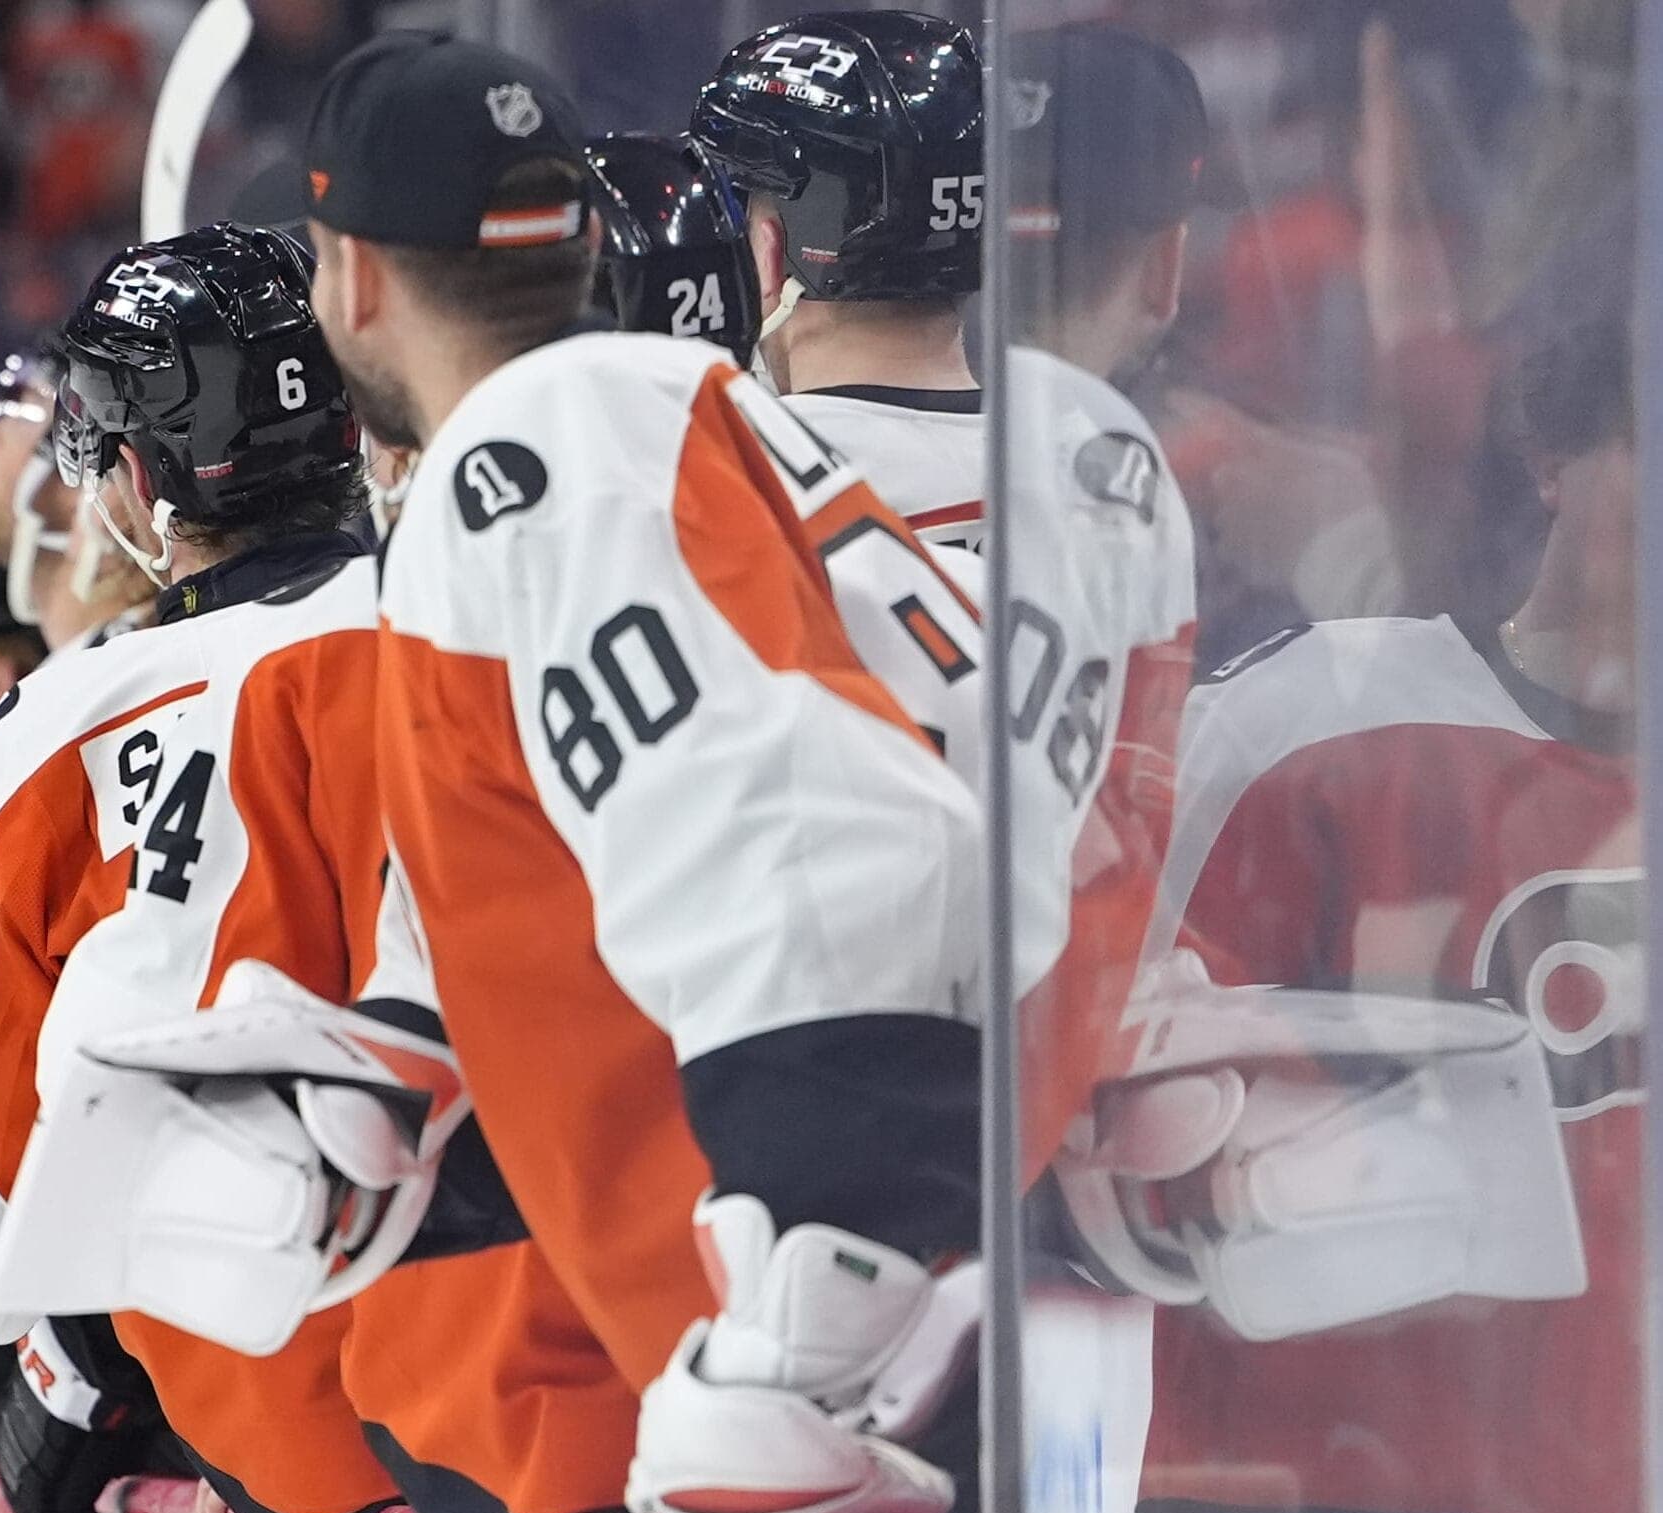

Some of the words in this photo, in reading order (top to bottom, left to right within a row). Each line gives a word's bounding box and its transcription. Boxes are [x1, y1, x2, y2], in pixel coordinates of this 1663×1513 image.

[929, 175, 985, 231] 55
[667, 272, 725, 338] 24
[276, 357, 307, 411] 6
[464, 447, 525, 518] 1
[542, 604, 700, 814] 80
